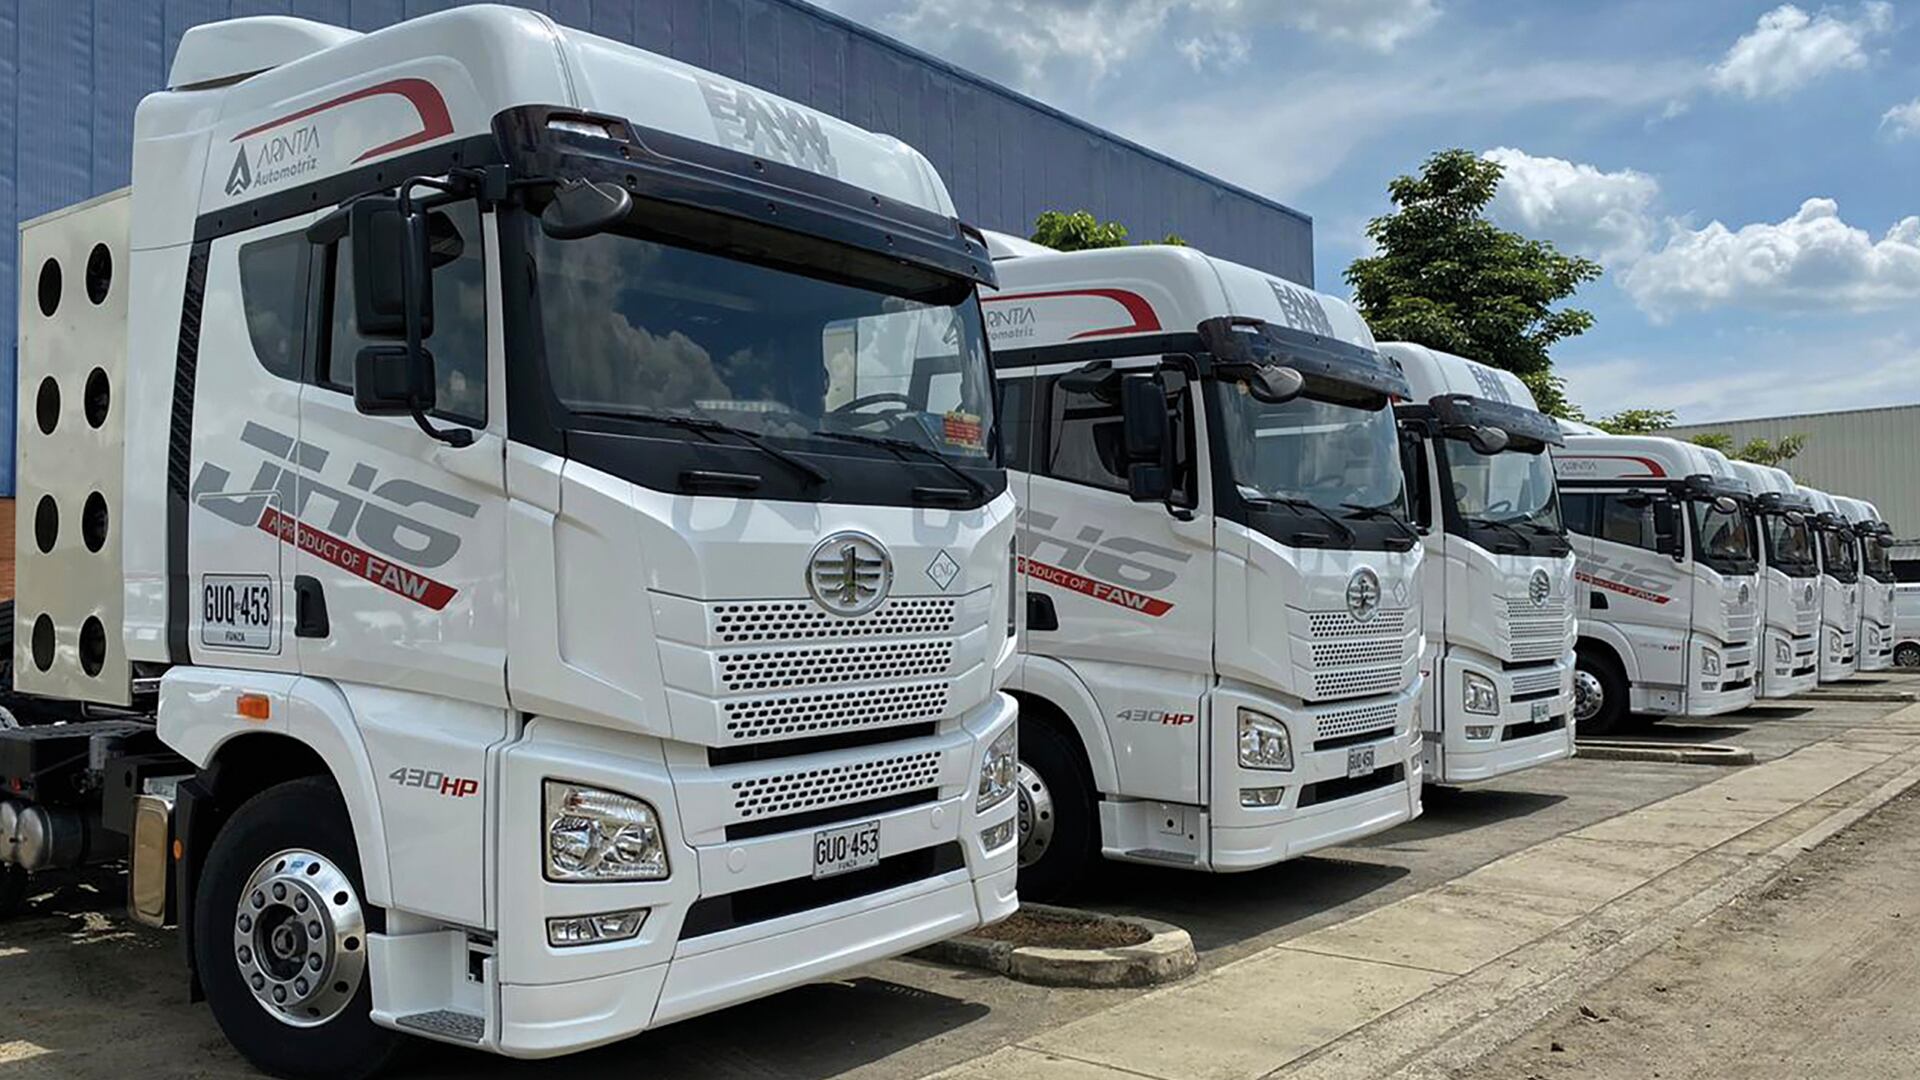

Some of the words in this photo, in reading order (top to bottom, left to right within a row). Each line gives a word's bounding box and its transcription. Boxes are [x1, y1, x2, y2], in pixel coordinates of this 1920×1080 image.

[253, 155, 317, 188] Automotriz
[267, 516, 278, 531] A
[281, 519, 339, 561] PRODUCT
[340, 549, 360, 568] OF
[365, 556, 430, 600] FAW
[1017, 558, 1068, 584] RODUCT
[1069, 577, 1088, 590] OF
[1092, 582, 1150, 609] FAW
[1116, 709, 1195, 726] 430HP
[389, 767, 479, 797] 430HP
